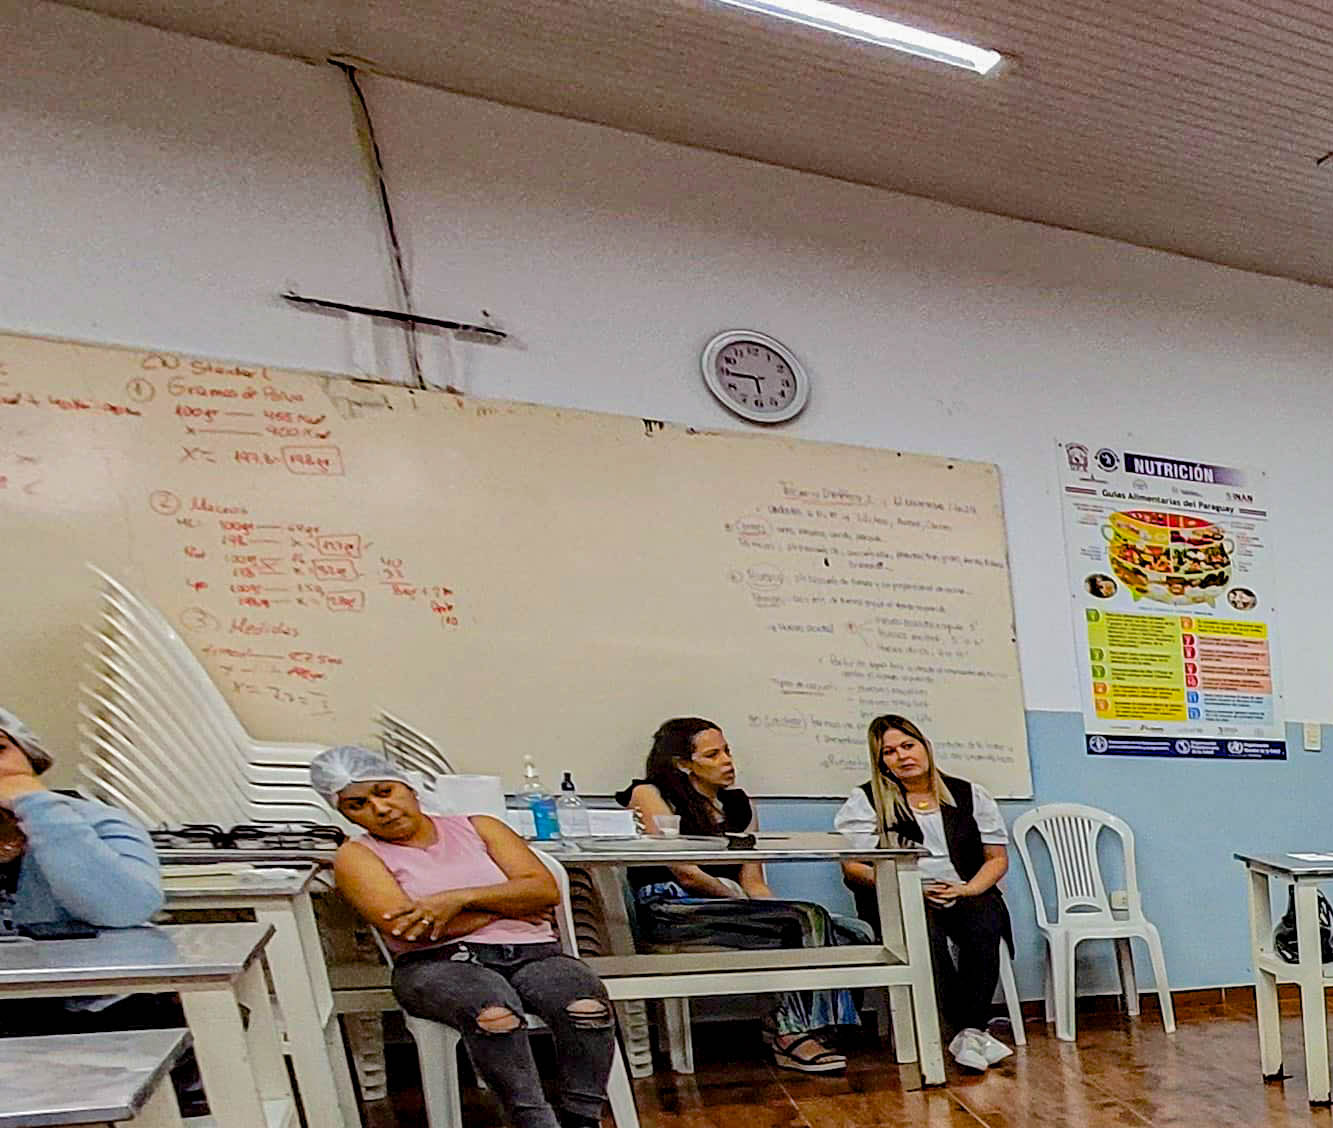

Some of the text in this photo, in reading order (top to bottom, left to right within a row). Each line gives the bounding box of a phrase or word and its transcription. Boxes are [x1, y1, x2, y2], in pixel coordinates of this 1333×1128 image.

[1133, 456, 1214, 484] NUTRICIÓN
[1102, 488, 1235, 514] Guías Alimentarias del Paraguay
